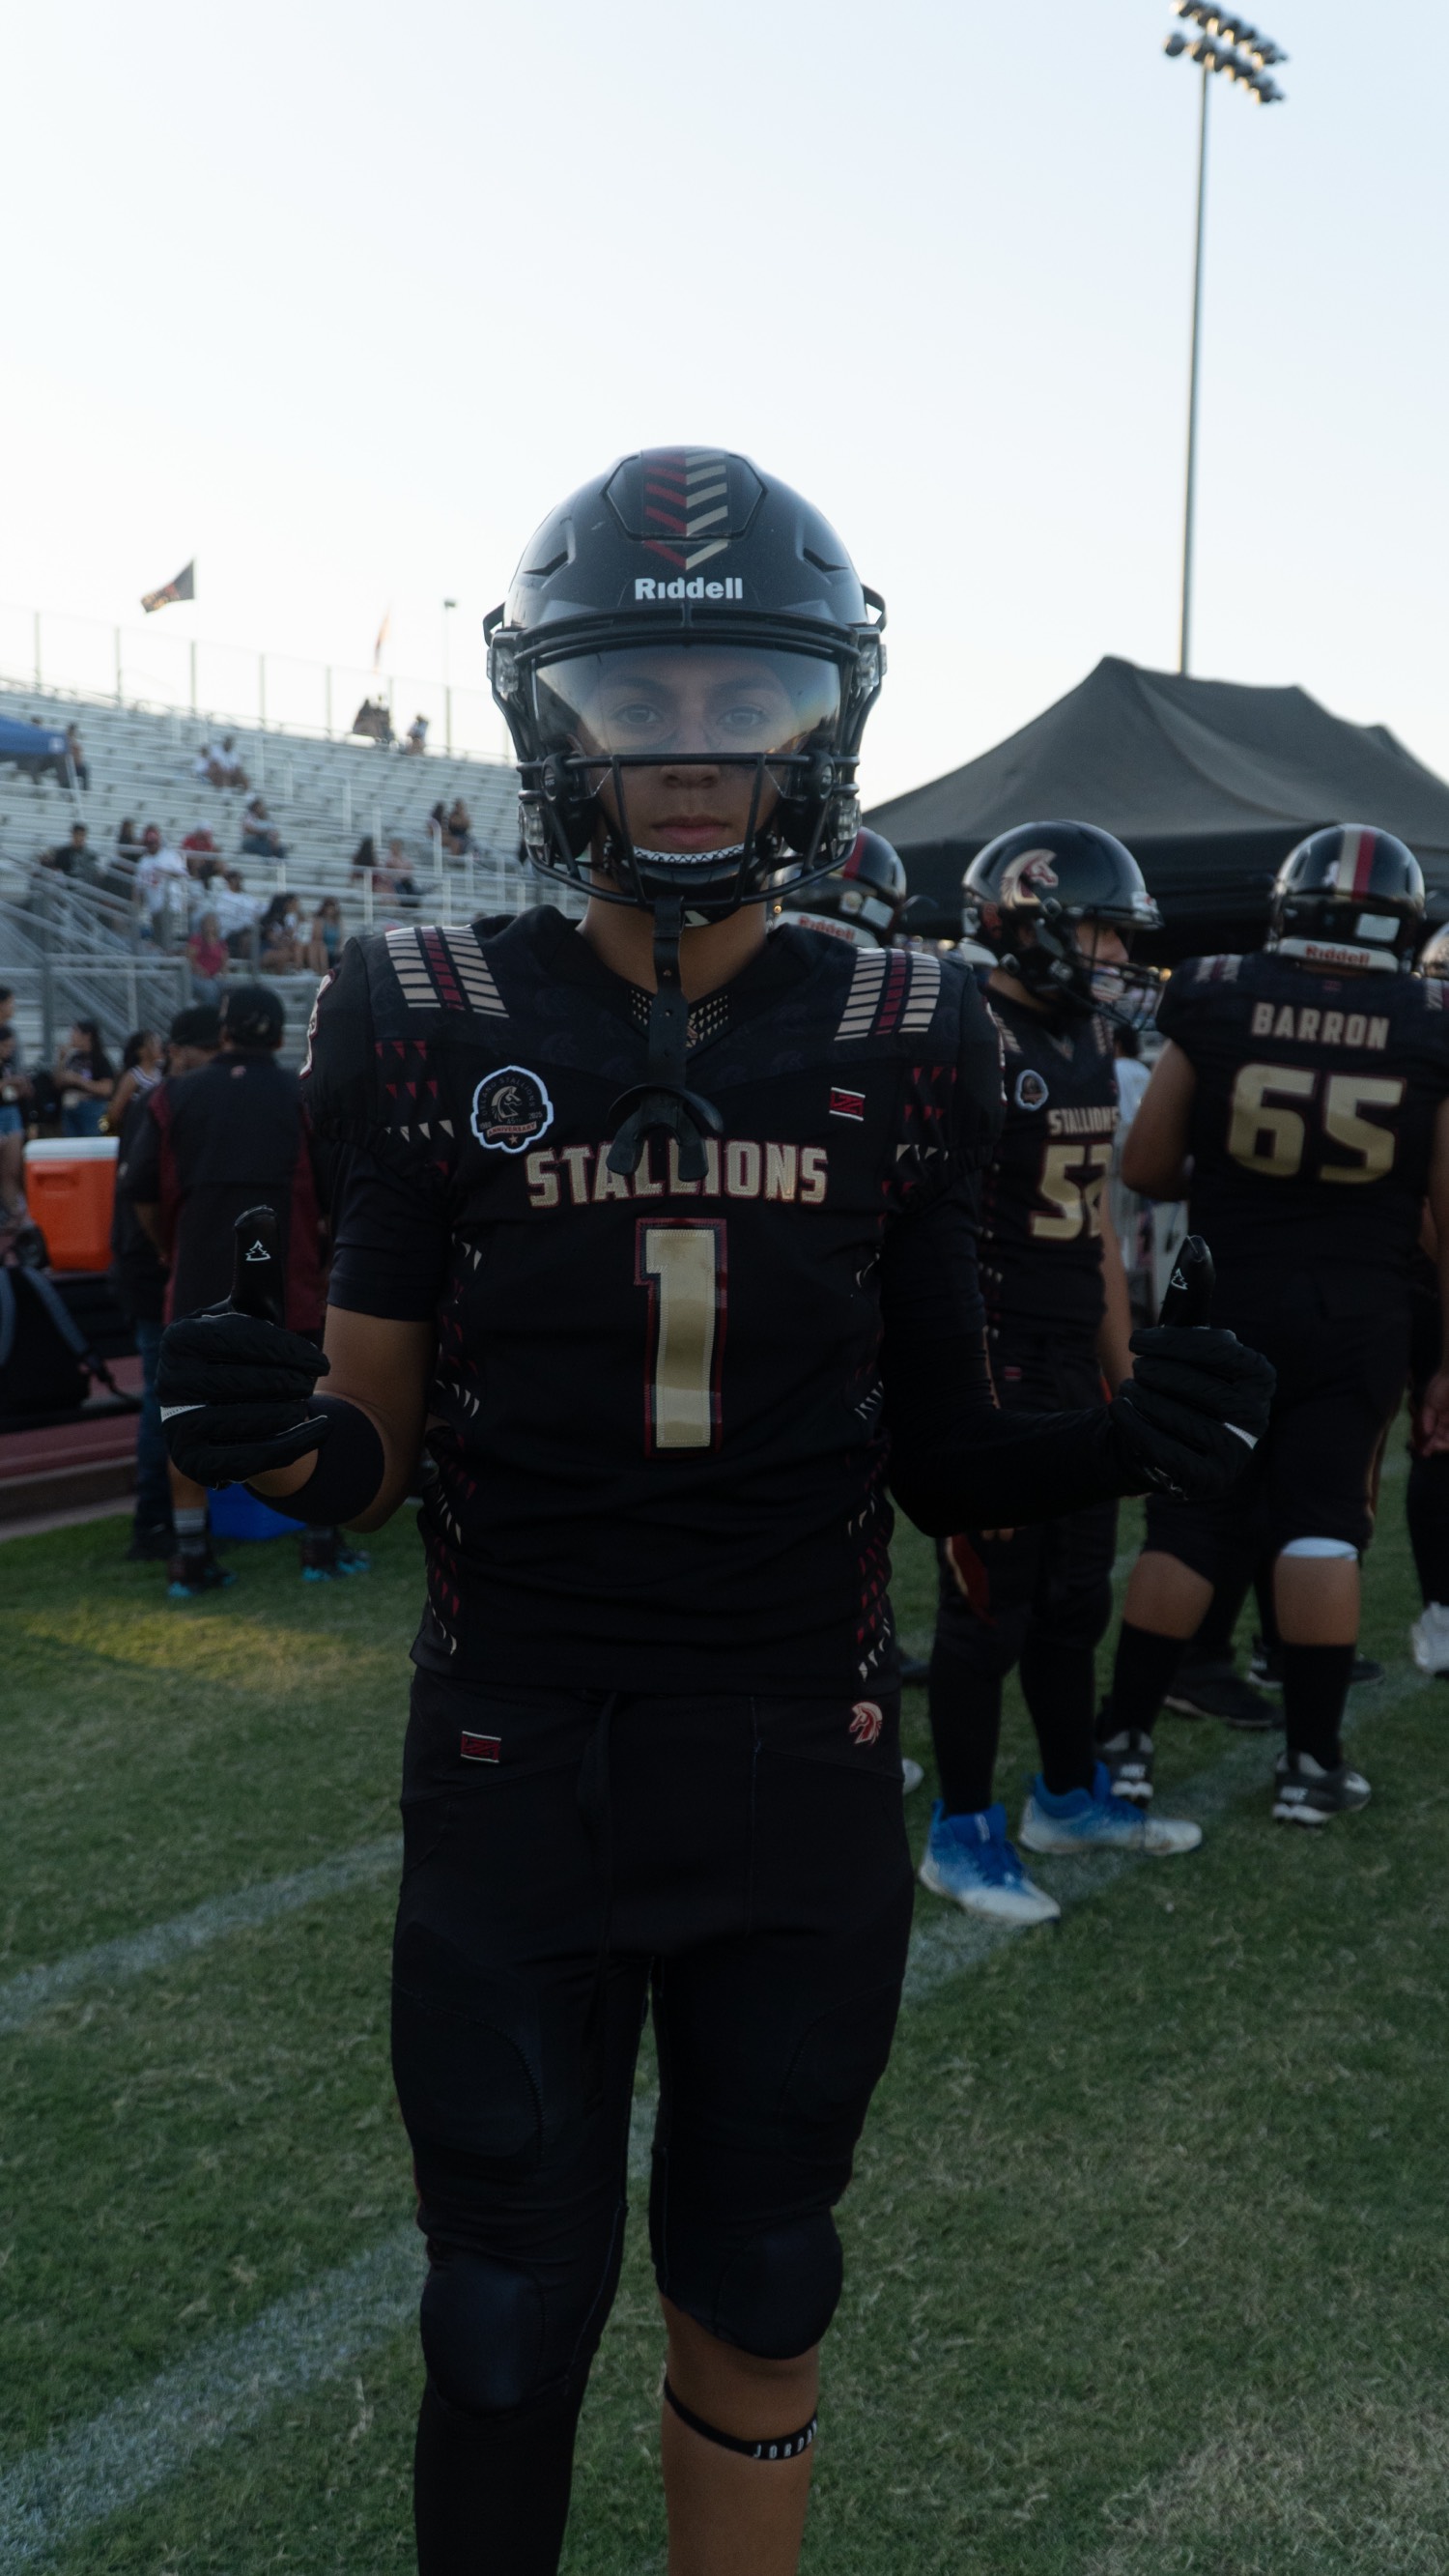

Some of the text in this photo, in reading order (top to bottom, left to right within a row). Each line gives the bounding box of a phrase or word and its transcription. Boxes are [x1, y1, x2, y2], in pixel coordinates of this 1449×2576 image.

[635, 577, 743, 600] Riddell
[1305, 946, 1371, 964] Riddell
[1251, 1002, 1390, 1051] BARRON
[488, 1123, 536, 1135] ANNIVERSARY
[1225, 1061, 1406, 1186] 65
[525, 1137, 829, 1208] STALLIONS
[634, 1217, 728, 1461] 1
